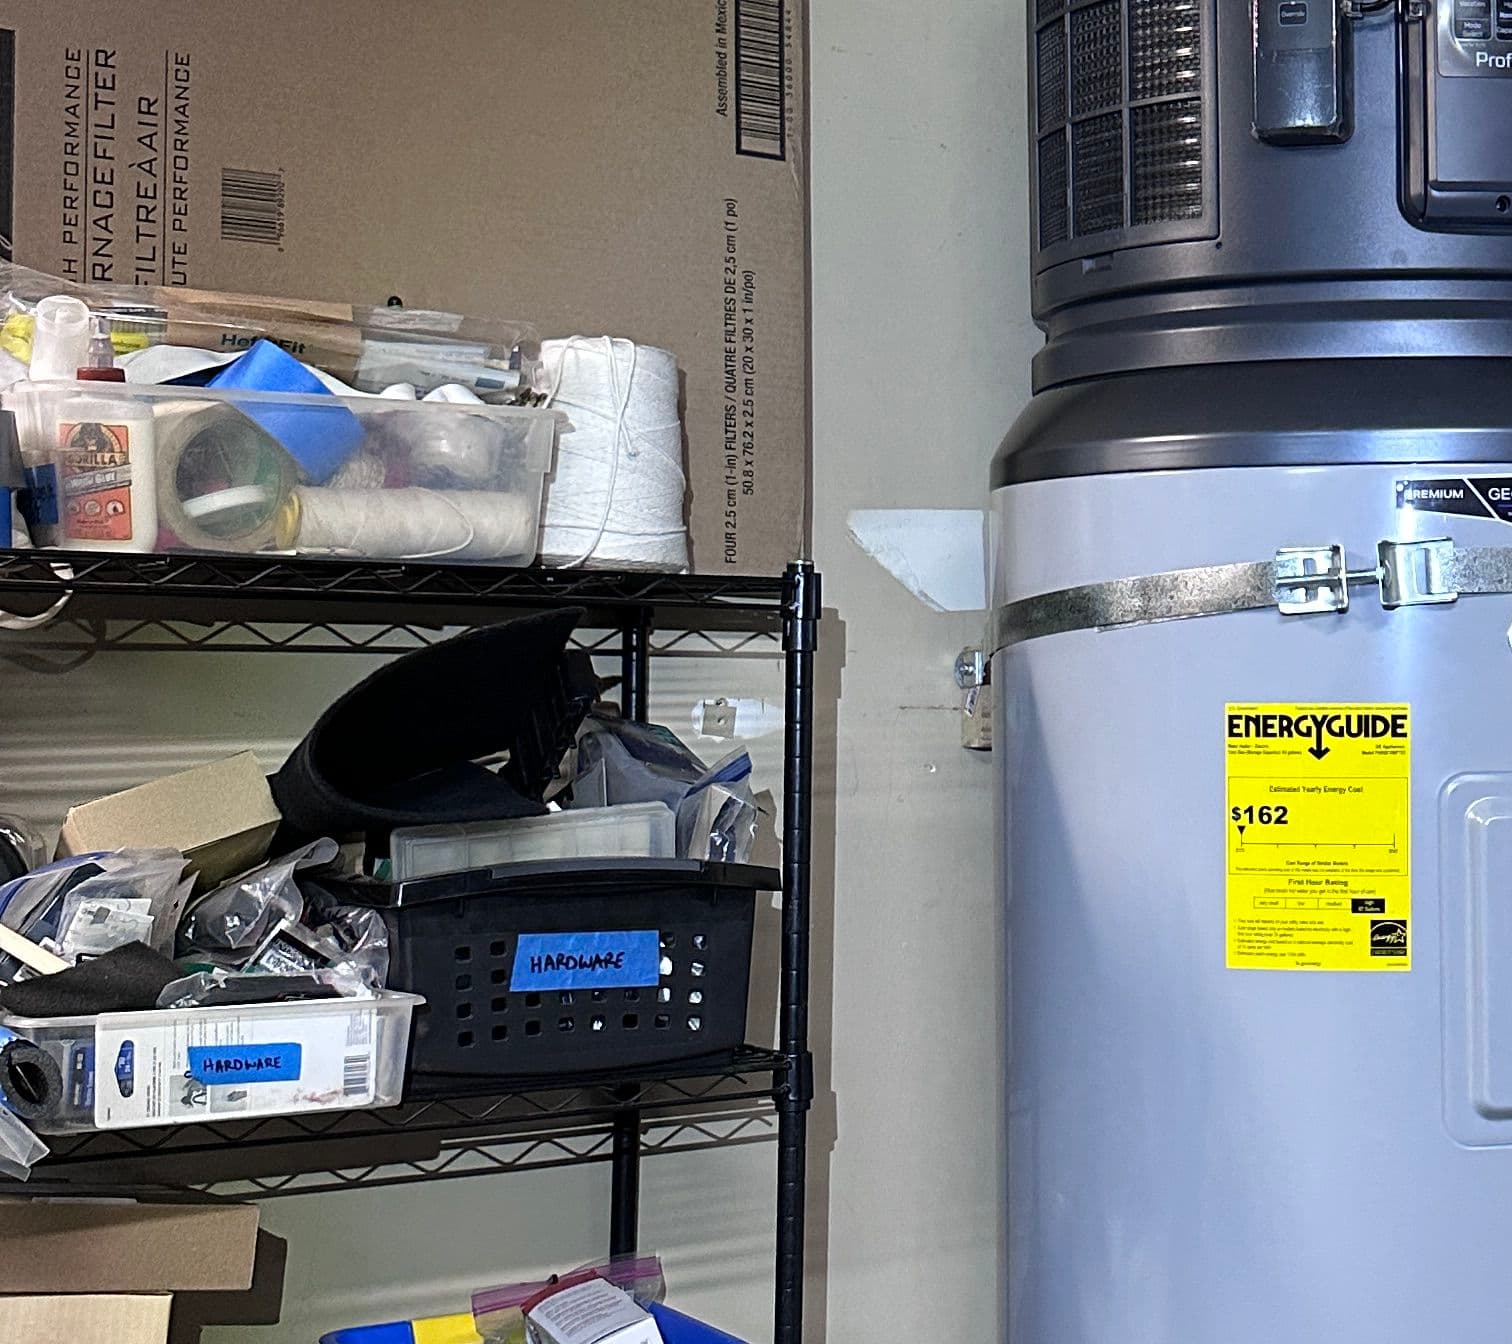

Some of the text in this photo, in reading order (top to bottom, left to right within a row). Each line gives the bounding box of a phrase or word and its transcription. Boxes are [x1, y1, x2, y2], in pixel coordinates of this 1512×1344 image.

[716, 38, 728, 50] in
[715, 50, 729, 118] Assembled
[62, 47, 82, 244] PERFORMANCE
[172, 52, 191, 232] PERFORMANCE
[724, 198, 739, 218] po)
[724, 220, 739, 232] (1
[726, 234, 737, 254] cm
[724, 256, 738, 276] 2,5
[724, 277, 737, 295] DE
[724, 297, 737, 345] FILTRES
[744, 317, 754, 326] x
[742, 327, 754, 343] 30
[744, 345, 754, 354] x
[724, 346, 737, 394] QUATRE
[742, 355, 757, 375] (20
[744, 378, 754, 397] cm
[742, 398, 754, 418] 2.5
[724, 404, 737, 451] FILTERS
[744, 420, 754, 428] x
[742, 430, 754, 456] 76.2
[724, 454, 739, 486] (1-in)
[744, 459, 754, 467] x
[742, 469, 754, 496] 50.8
[726, 488, 737, 508] cm
[724, 509, 737, 530] 2.5
[724, 531, 737, 564] FOUR
[1228, 714, 1408, 739] ENERGYGUIDE
[1323, 786, 1347, 795] Energy
[1231, 805, 1289, 825] $162
[529, 951, 626, 974] HARDWARE
[203, 1055, 283, 1072] HARDWARE
